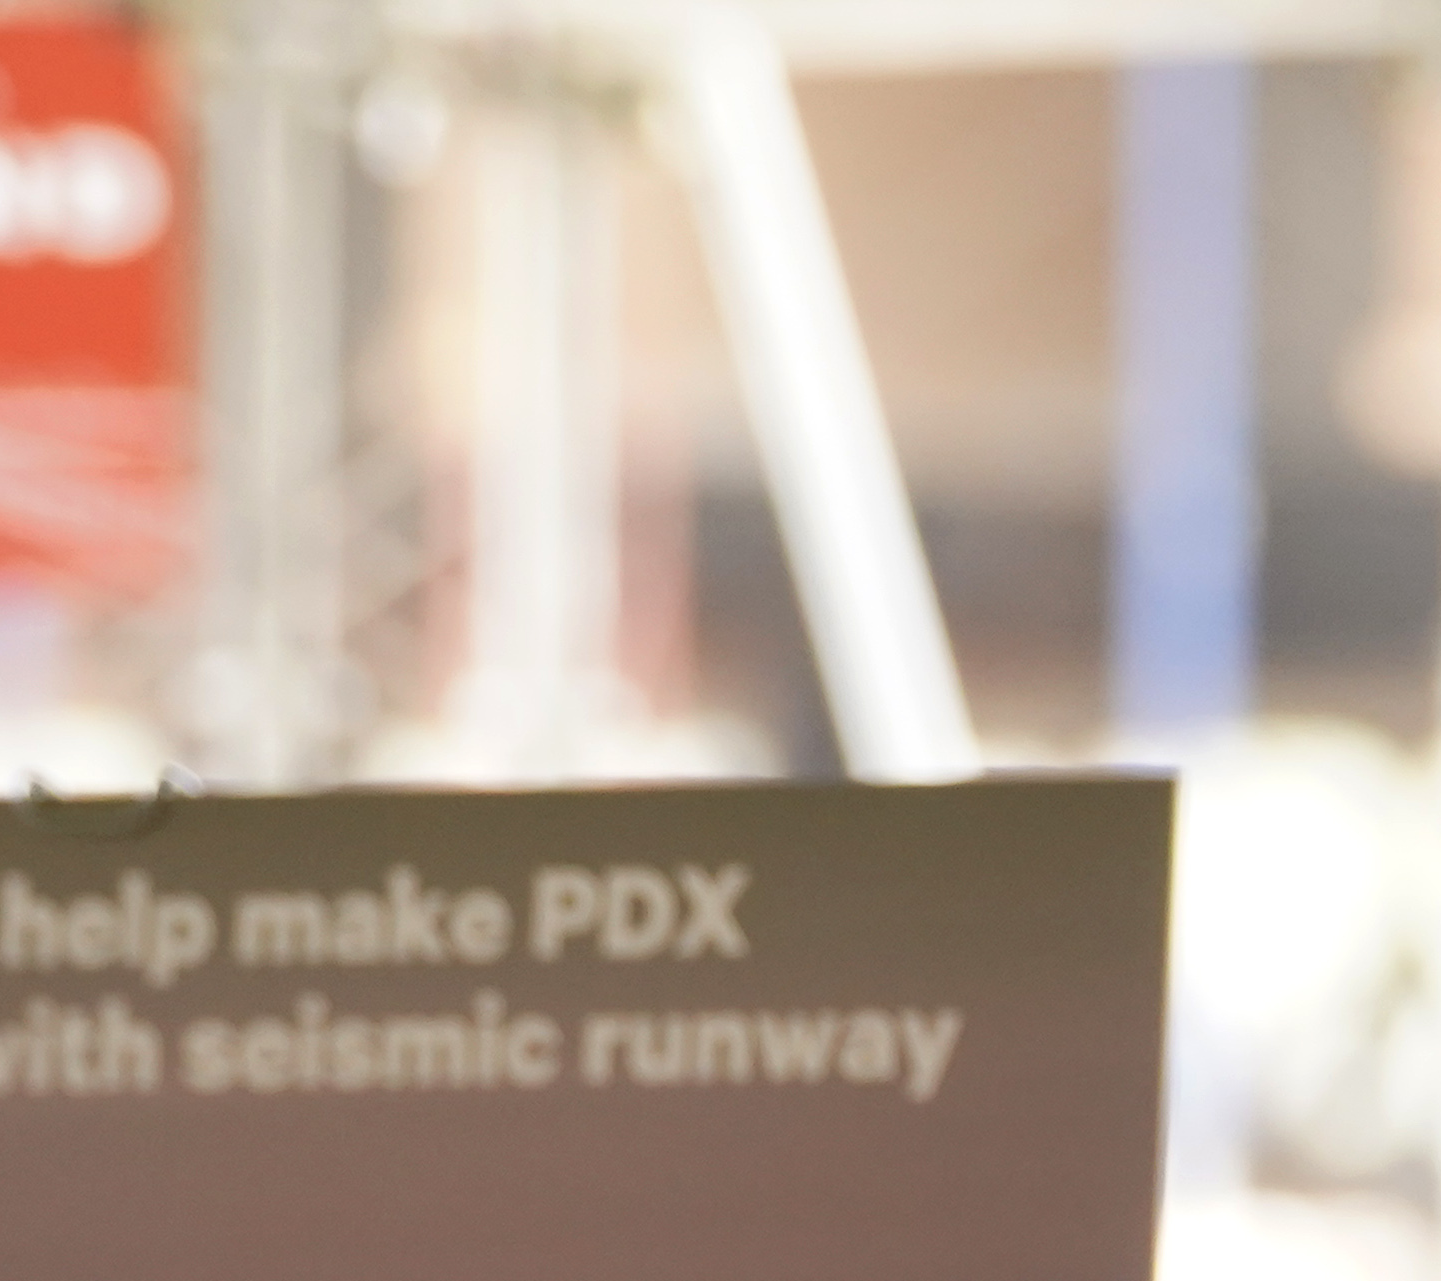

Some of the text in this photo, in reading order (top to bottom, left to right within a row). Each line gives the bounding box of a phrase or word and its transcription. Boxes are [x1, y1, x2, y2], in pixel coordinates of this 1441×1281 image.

[235, 865, 512, 965] make
[531, 864, 751, 960] PDX
[182, 990, 559, 1093] seismic
[581, 1008, 962, 1103] runway
